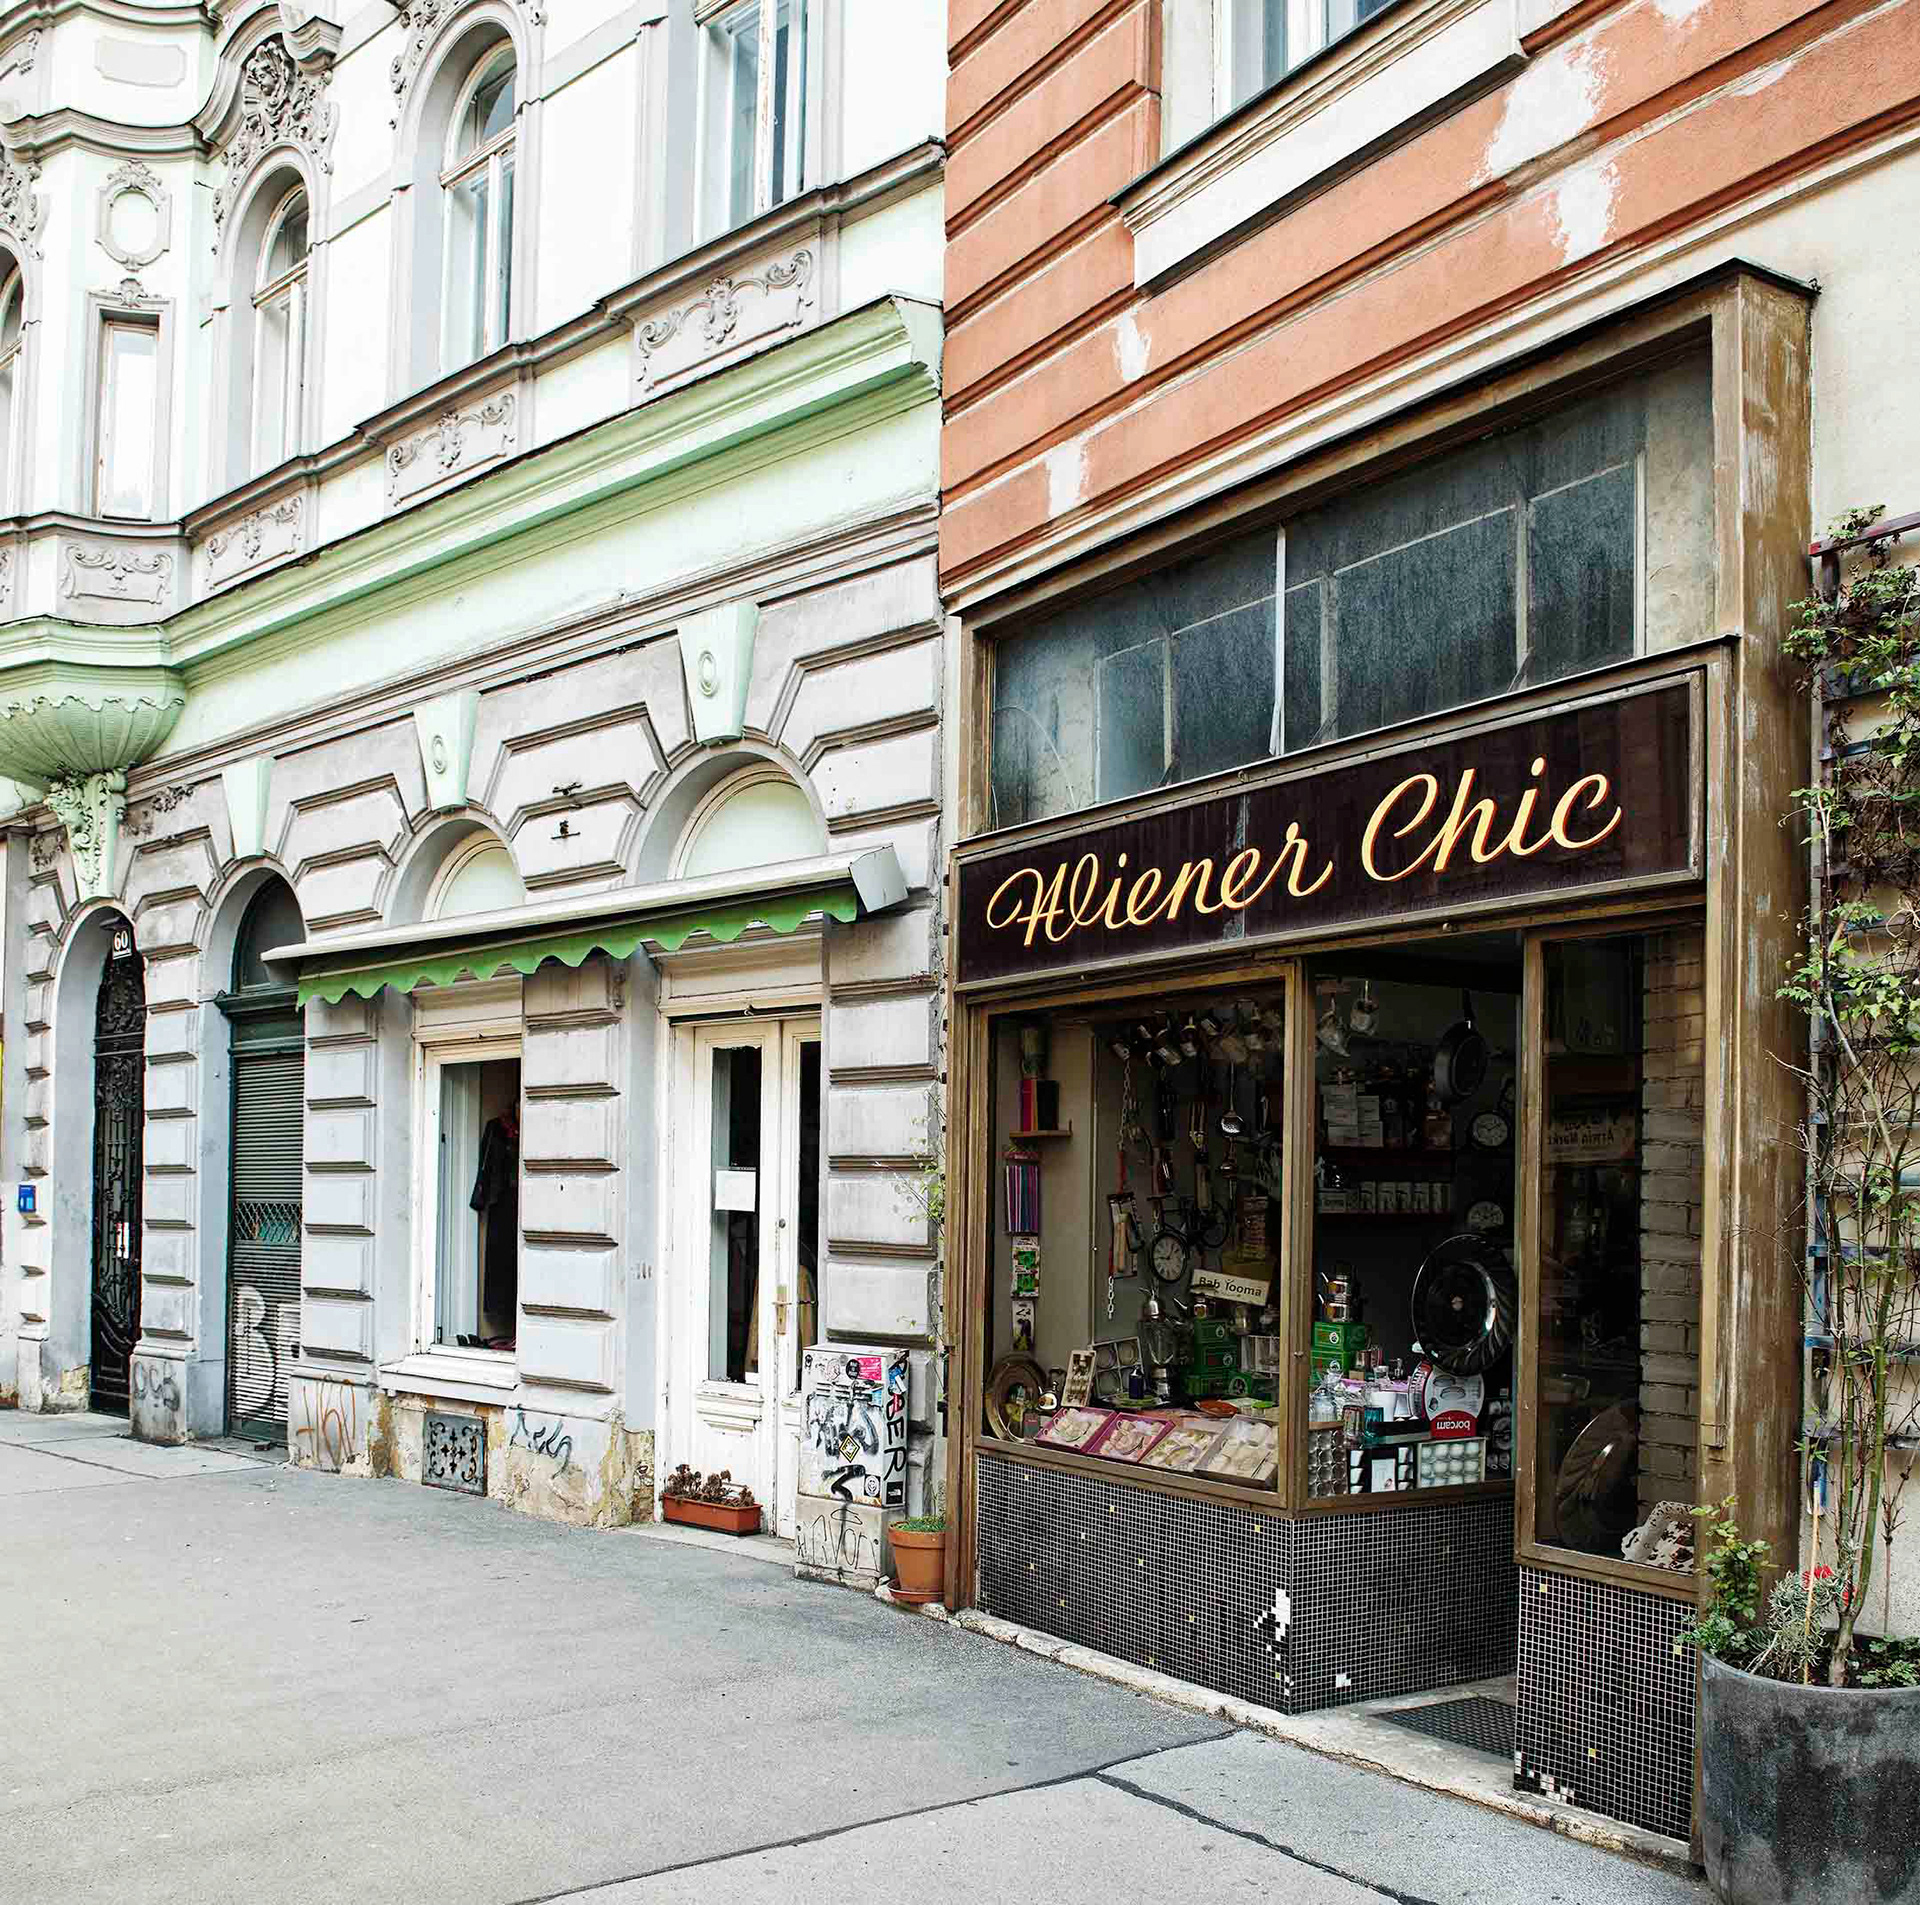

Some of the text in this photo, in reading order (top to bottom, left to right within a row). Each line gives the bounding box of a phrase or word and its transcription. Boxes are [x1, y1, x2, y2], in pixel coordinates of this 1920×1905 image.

[987, 756, 1623, 947] Wiener Chic
[114, 930, 129, 951] 60
[1436, 1420, 1471, 1431] borcam
